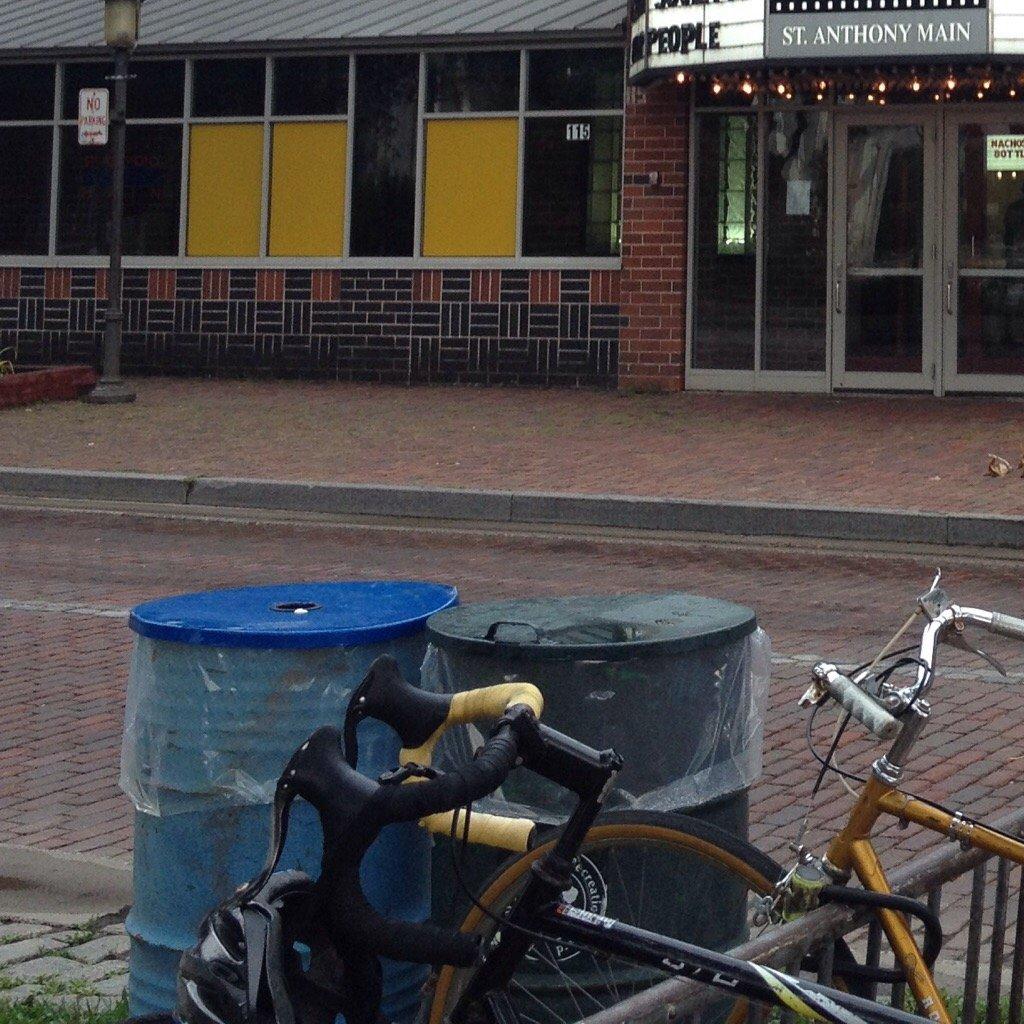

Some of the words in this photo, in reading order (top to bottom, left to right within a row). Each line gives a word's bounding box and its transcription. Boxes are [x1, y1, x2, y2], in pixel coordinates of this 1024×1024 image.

[650, 22, 721, 56] PEOPLE
[782, 25, 809, 46] ST.
[814, 23, 912, 45] ANTHONY
[917, 22, 971, 44] MAIN
[87, 97, 101, 111] NO
